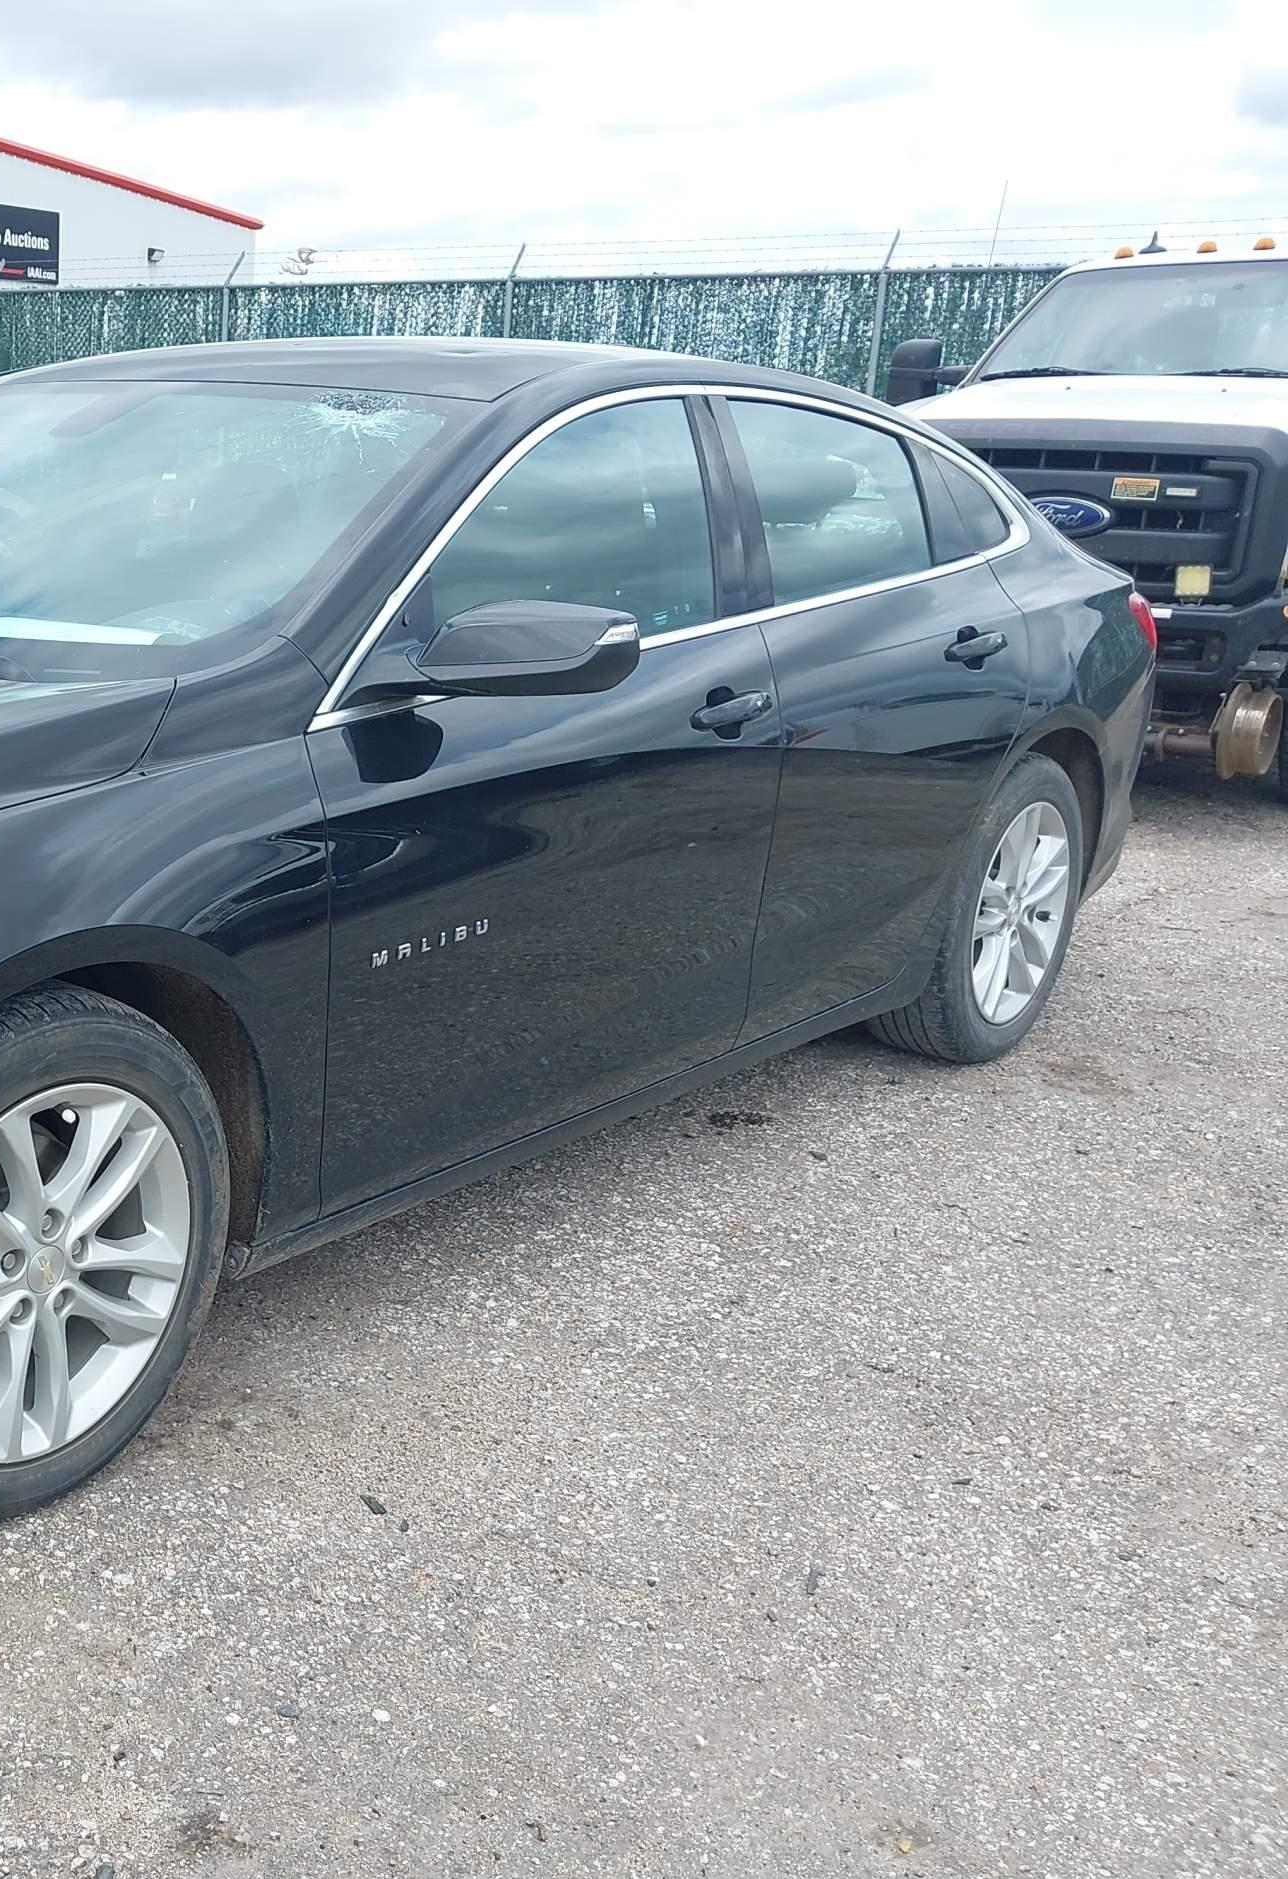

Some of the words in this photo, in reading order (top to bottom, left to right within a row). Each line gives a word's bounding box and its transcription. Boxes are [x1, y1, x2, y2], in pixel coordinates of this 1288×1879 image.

[3, 229, 50, 250] Auctions
[1035, 502, 1085, 526] Ford
[371, 919, 488, 968] MALIBU
